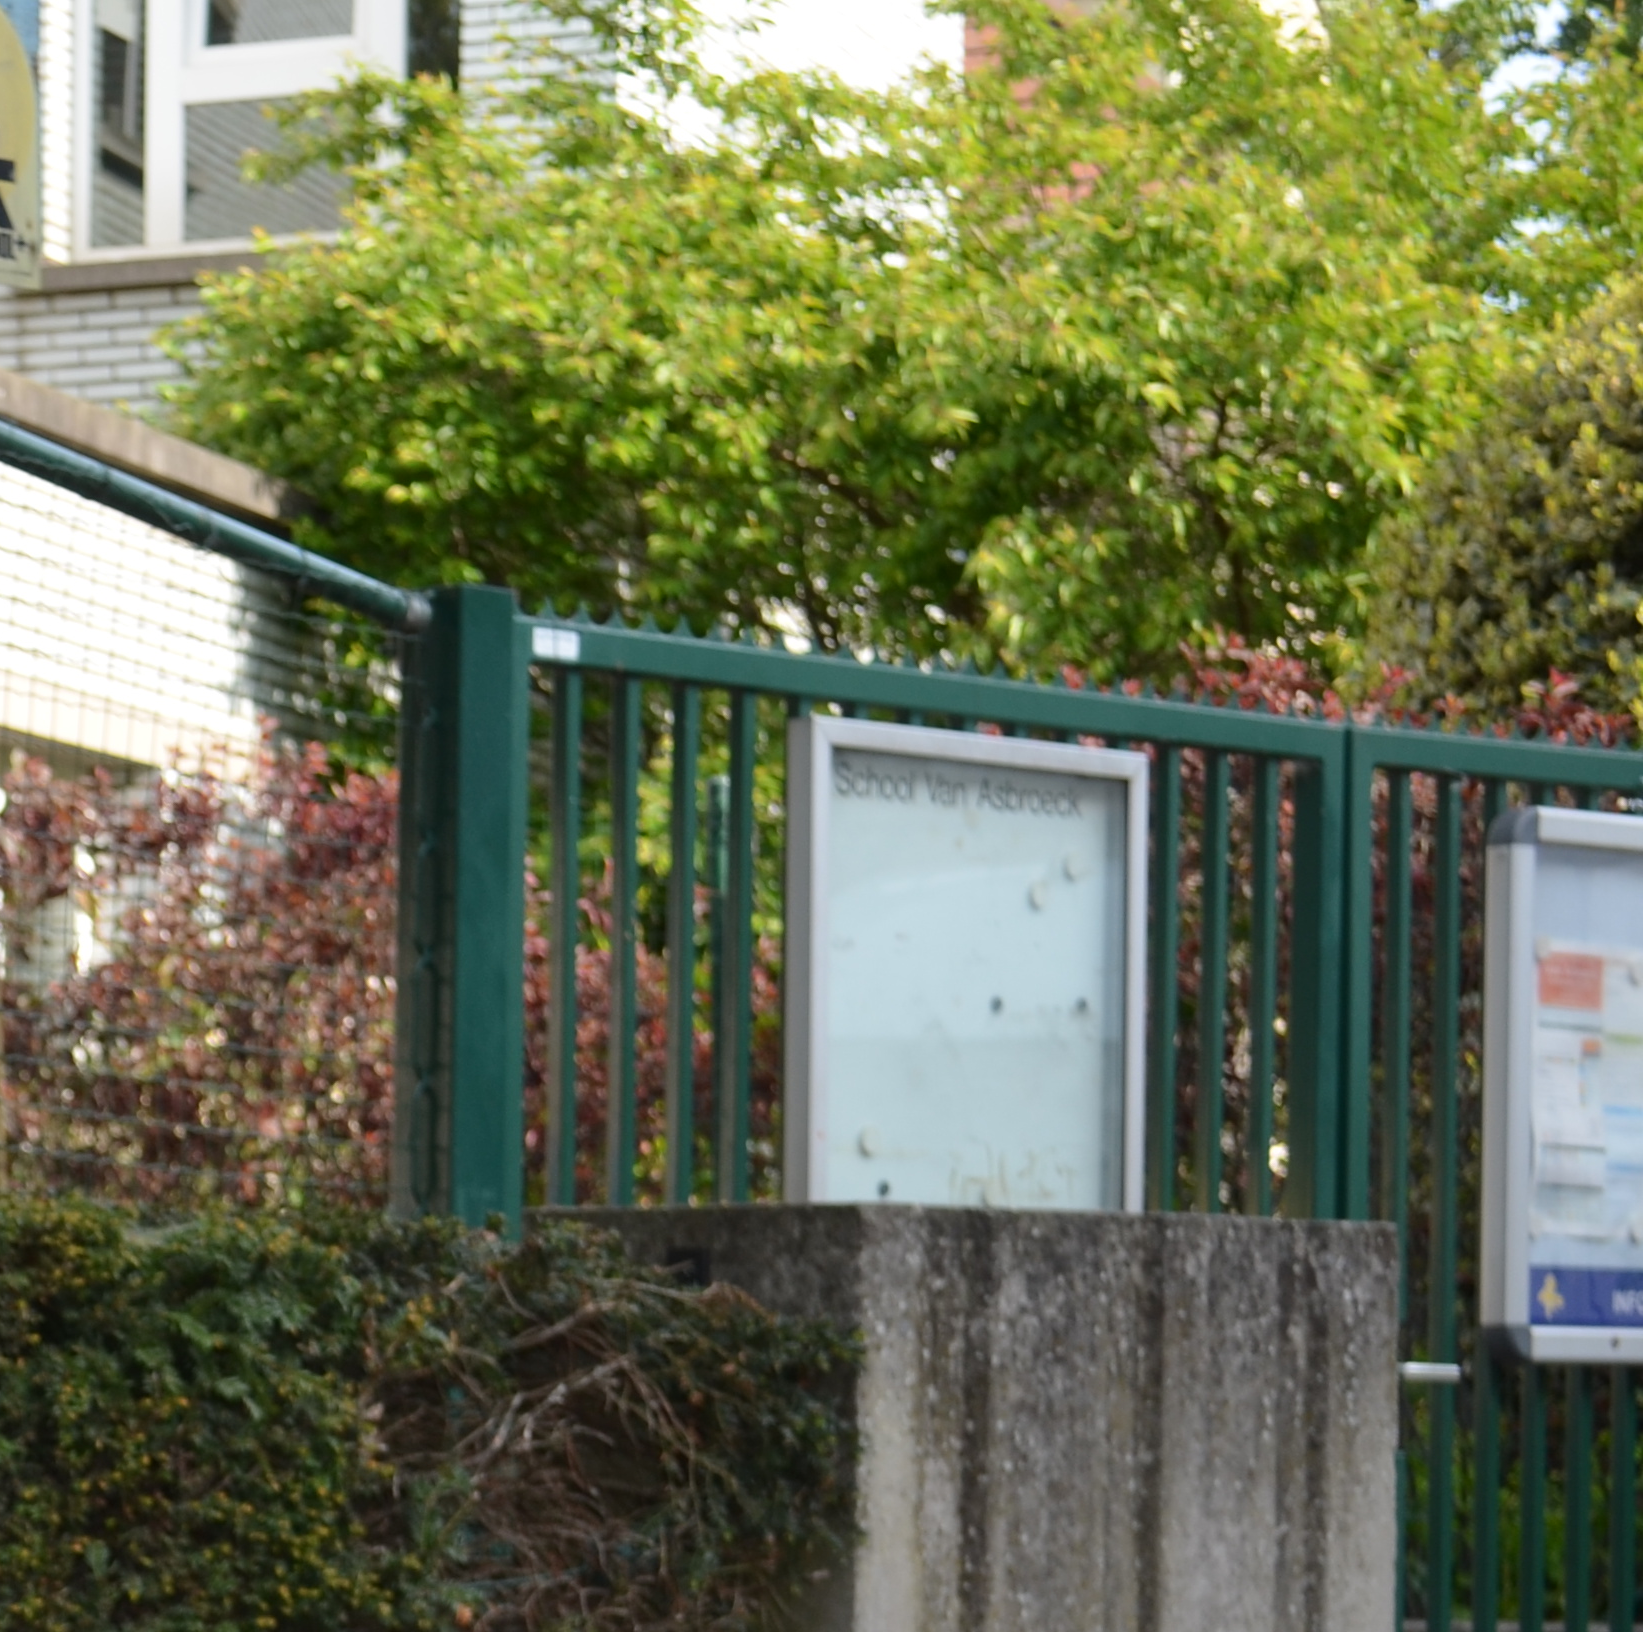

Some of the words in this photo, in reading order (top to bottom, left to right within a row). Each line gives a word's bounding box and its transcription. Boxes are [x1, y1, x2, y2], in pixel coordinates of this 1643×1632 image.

[834, 761, 914, 804] School
[925, 773, 965, 810] Van
[975, 778, 1083, 818] Asbroeck
